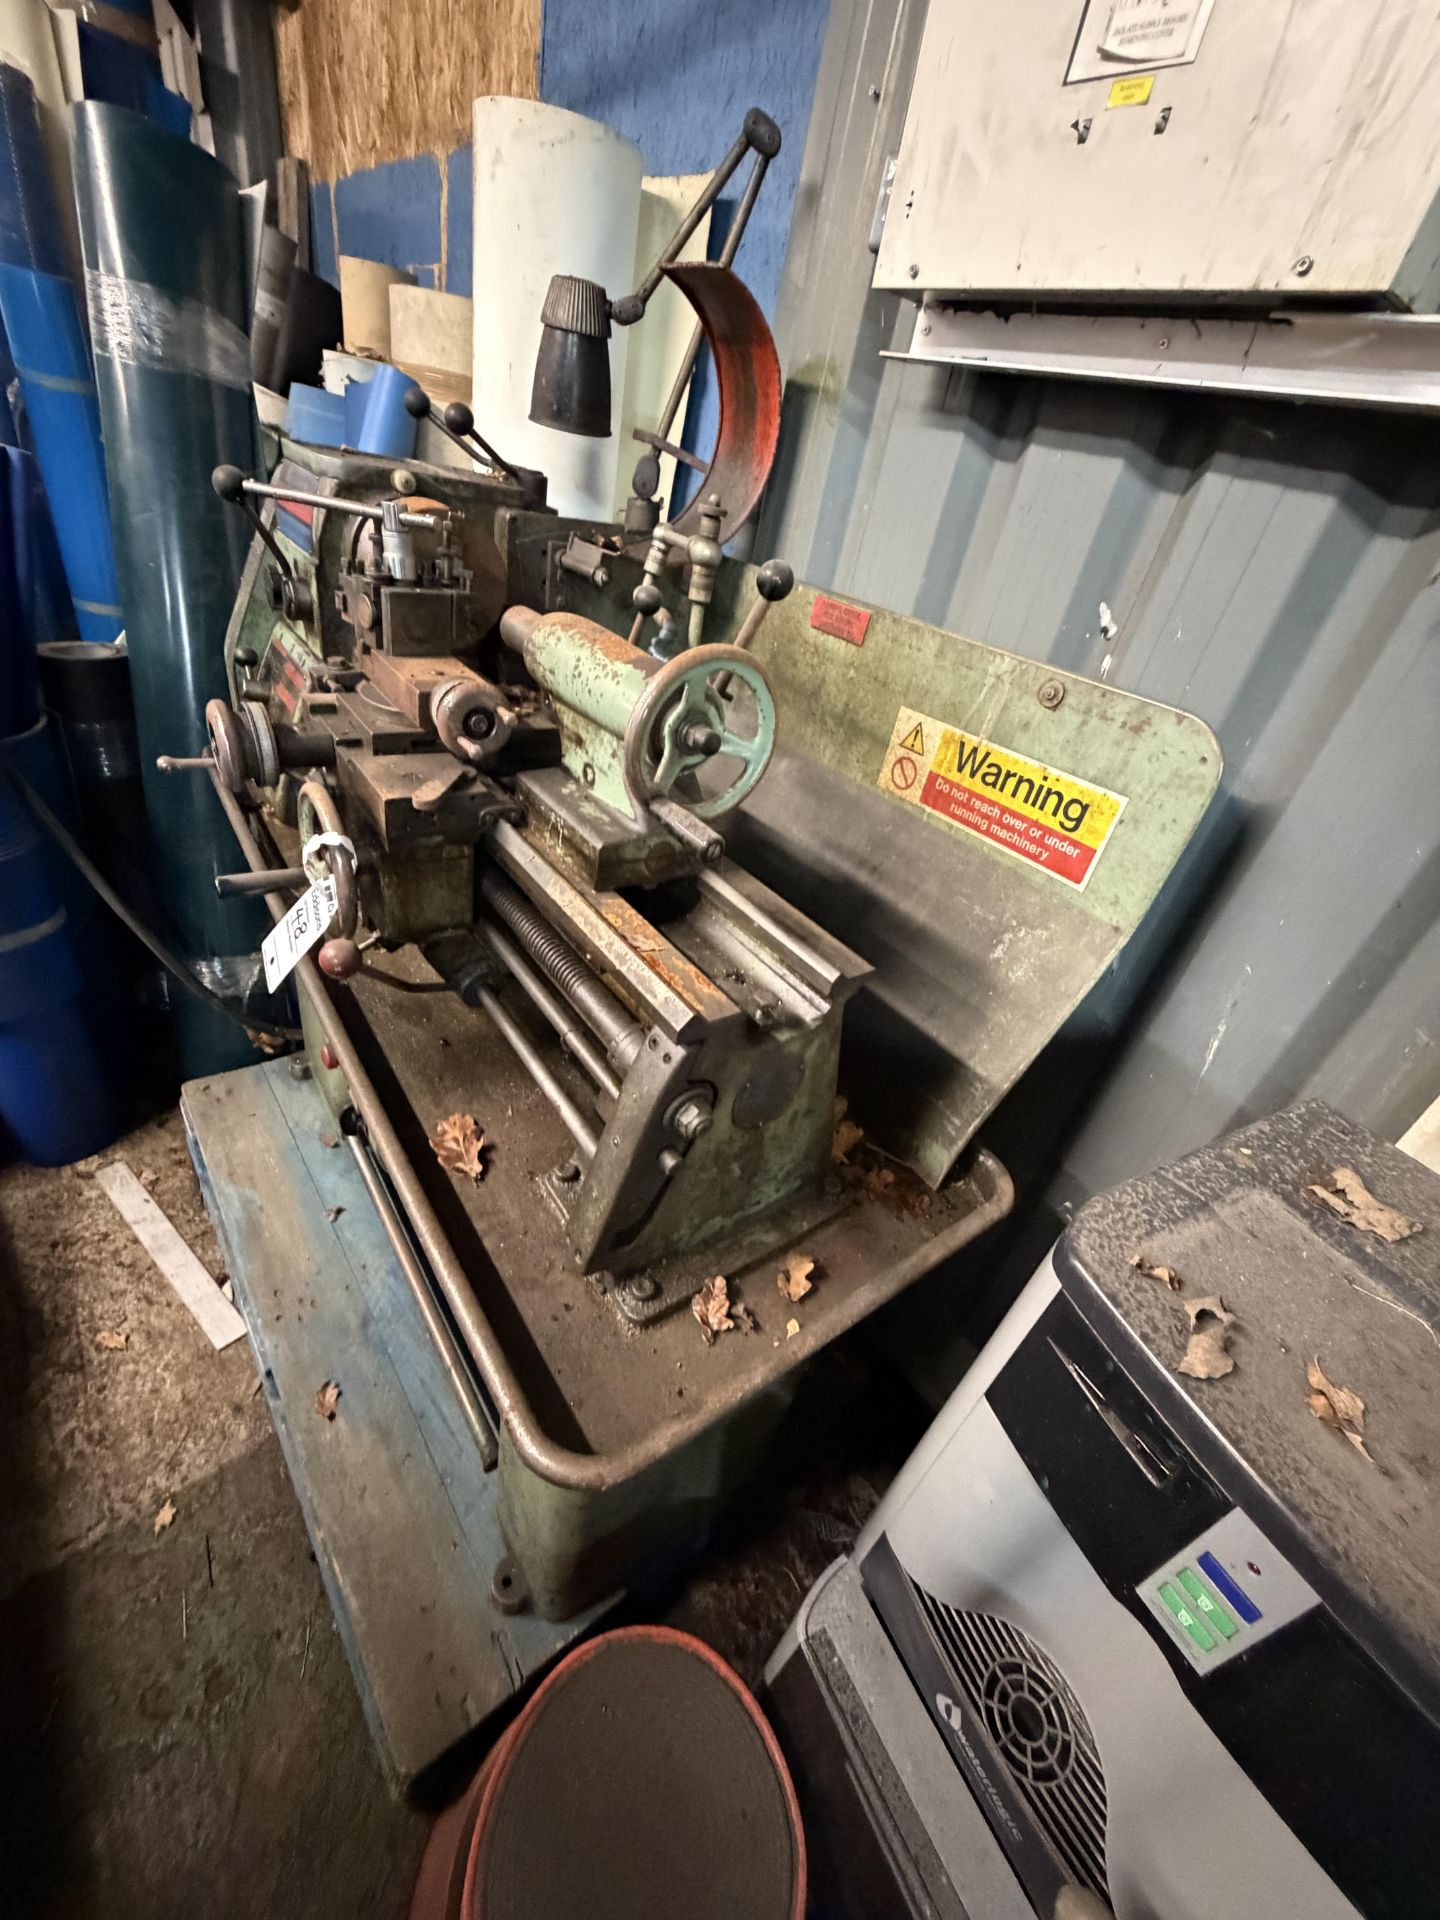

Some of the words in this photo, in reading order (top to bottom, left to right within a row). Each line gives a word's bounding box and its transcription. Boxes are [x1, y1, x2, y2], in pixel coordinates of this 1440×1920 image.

[935, 778, 949, 794] Do
[951, 787, 968, 804] not
[970, 795, 1000, 819] reach
[1002, 812, 1028, 832] over
[1029, 826, 1043, 839] or
[1044, 833, 1081, 859] under
[956, 740, 1090, 833] Warning
[950, 802, 988, 831] running
[990, 822, 1050, 862] machinery
[291, 907, 308, 939] 48
